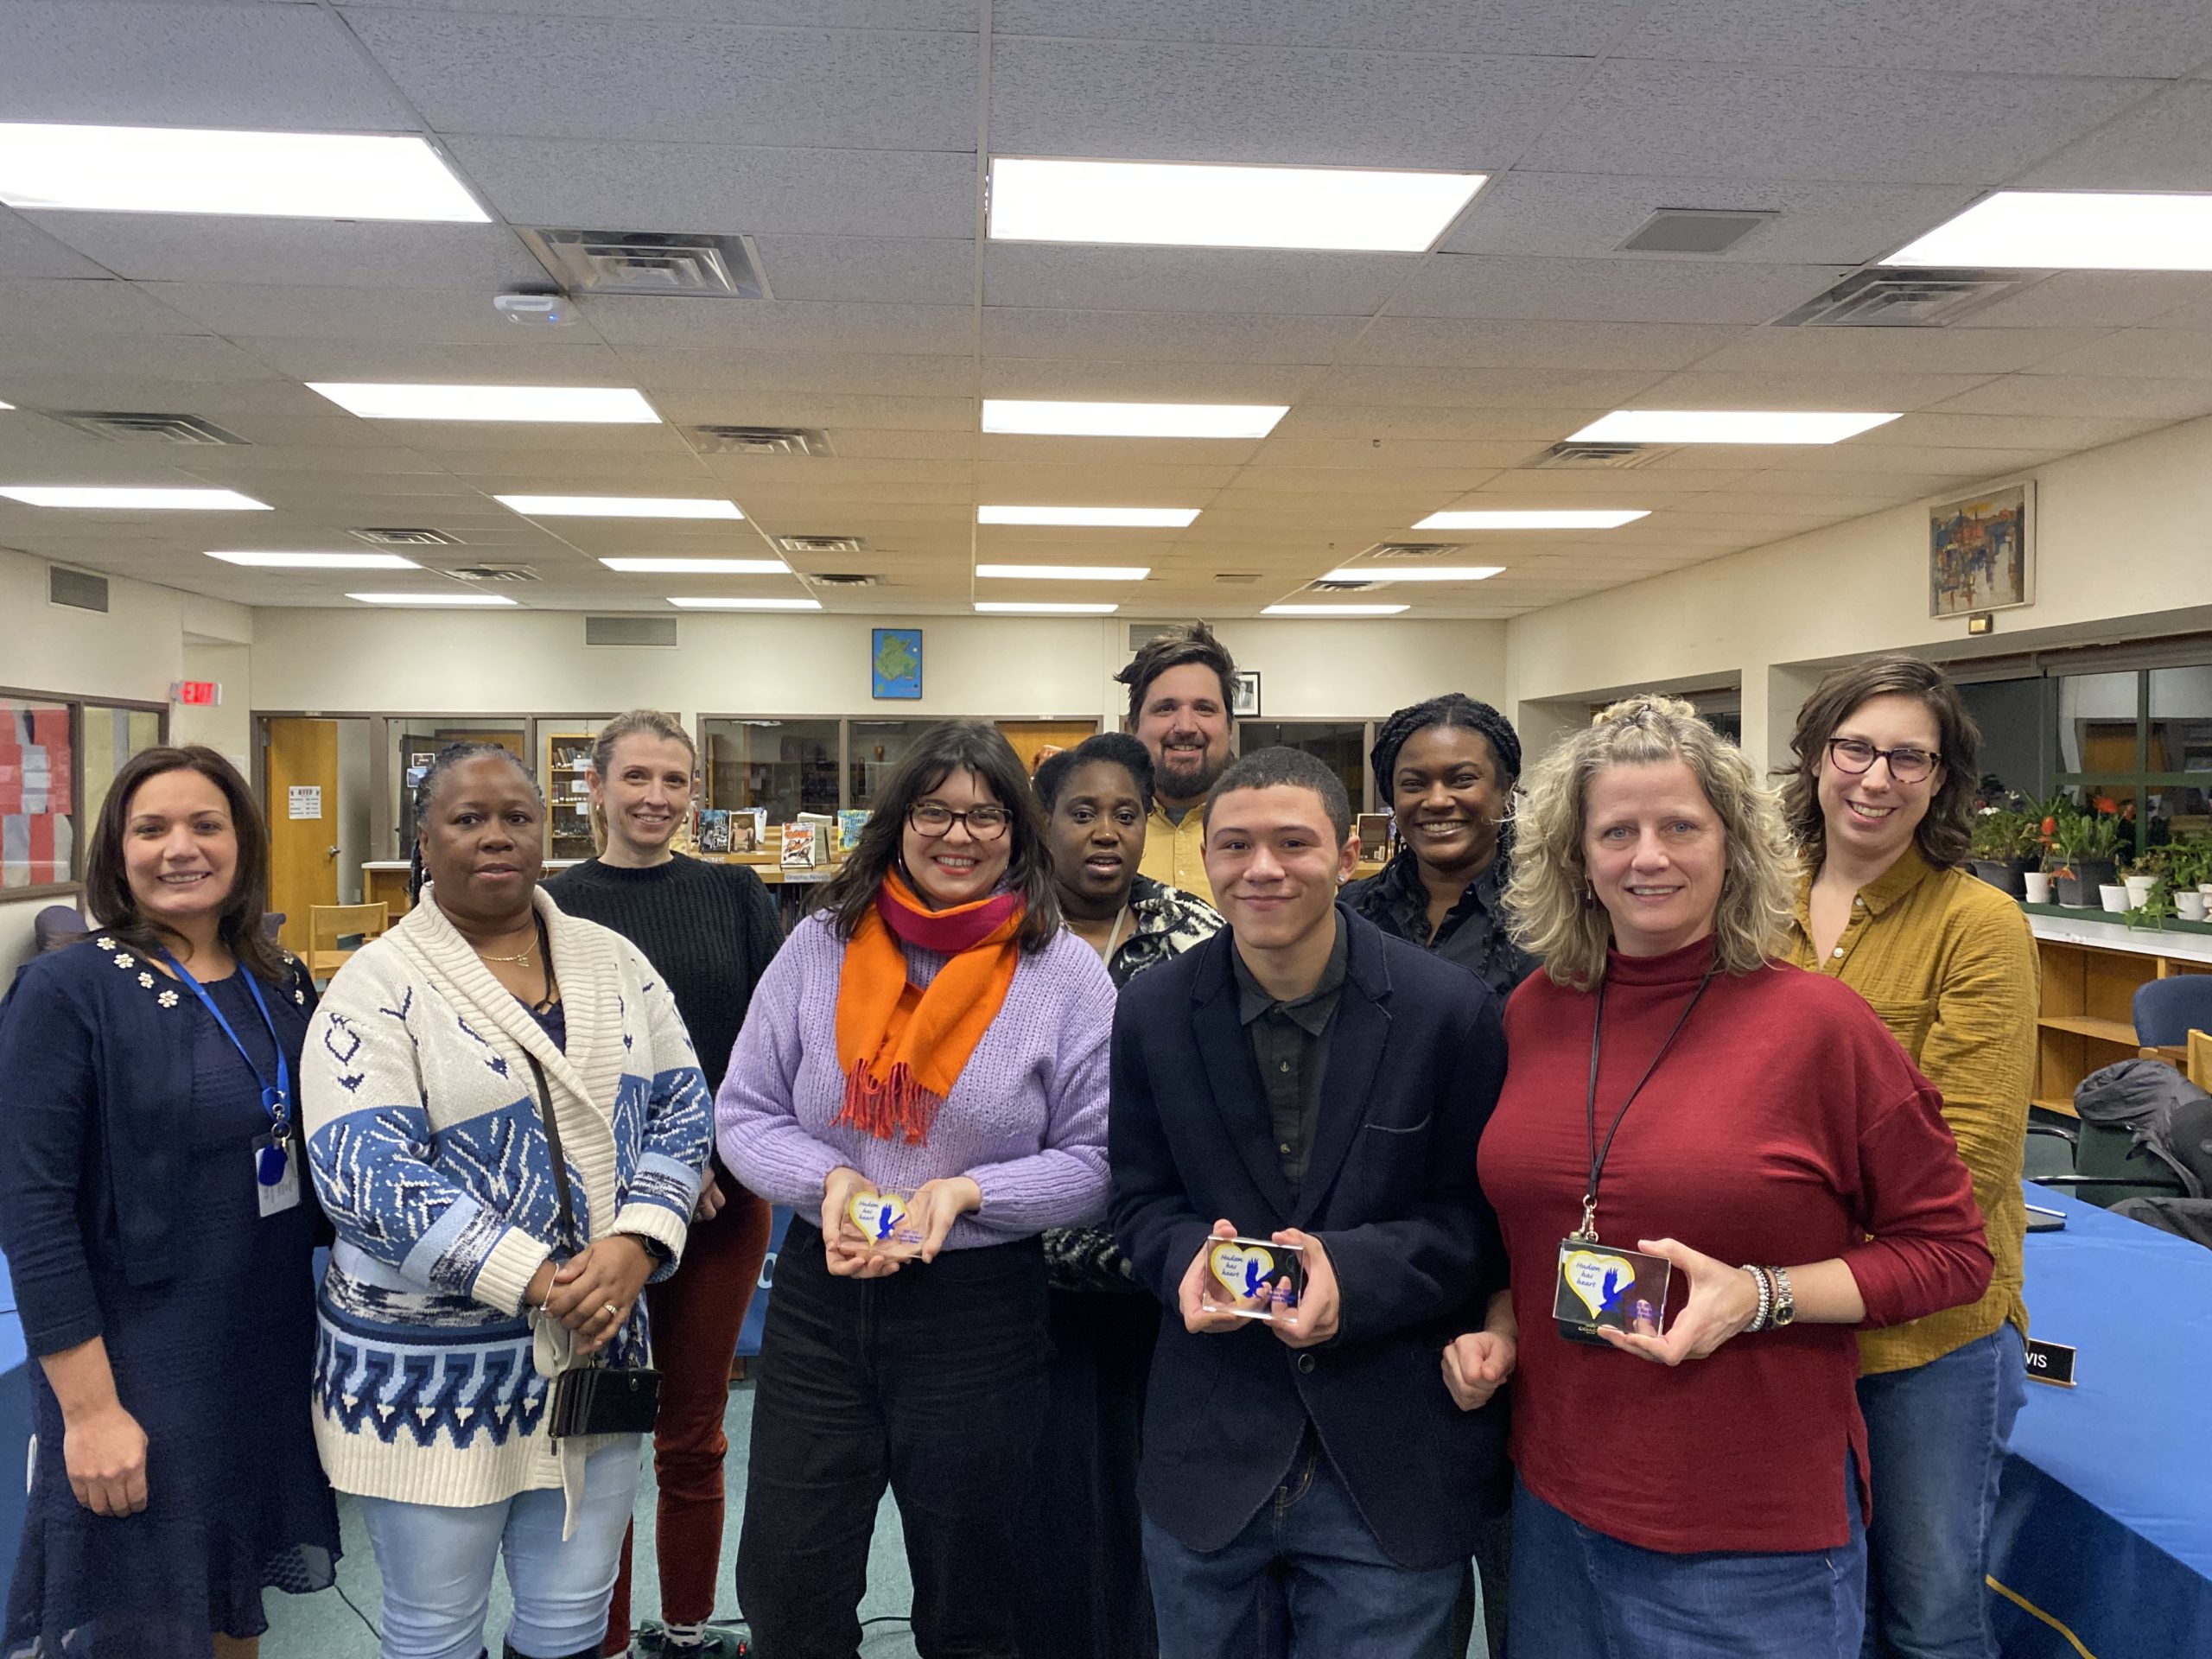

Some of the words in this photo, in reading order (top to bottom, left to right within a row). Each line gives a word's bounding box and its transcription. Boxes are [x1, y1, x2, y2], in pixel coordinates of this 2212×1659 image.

[183, 682, 213, 705] EXIT
[1576, 1262, 1600, 1271] Hudson
[1580, 1270, 1593, 1279] has
[1577, 1279, 1596, 1287] heart
